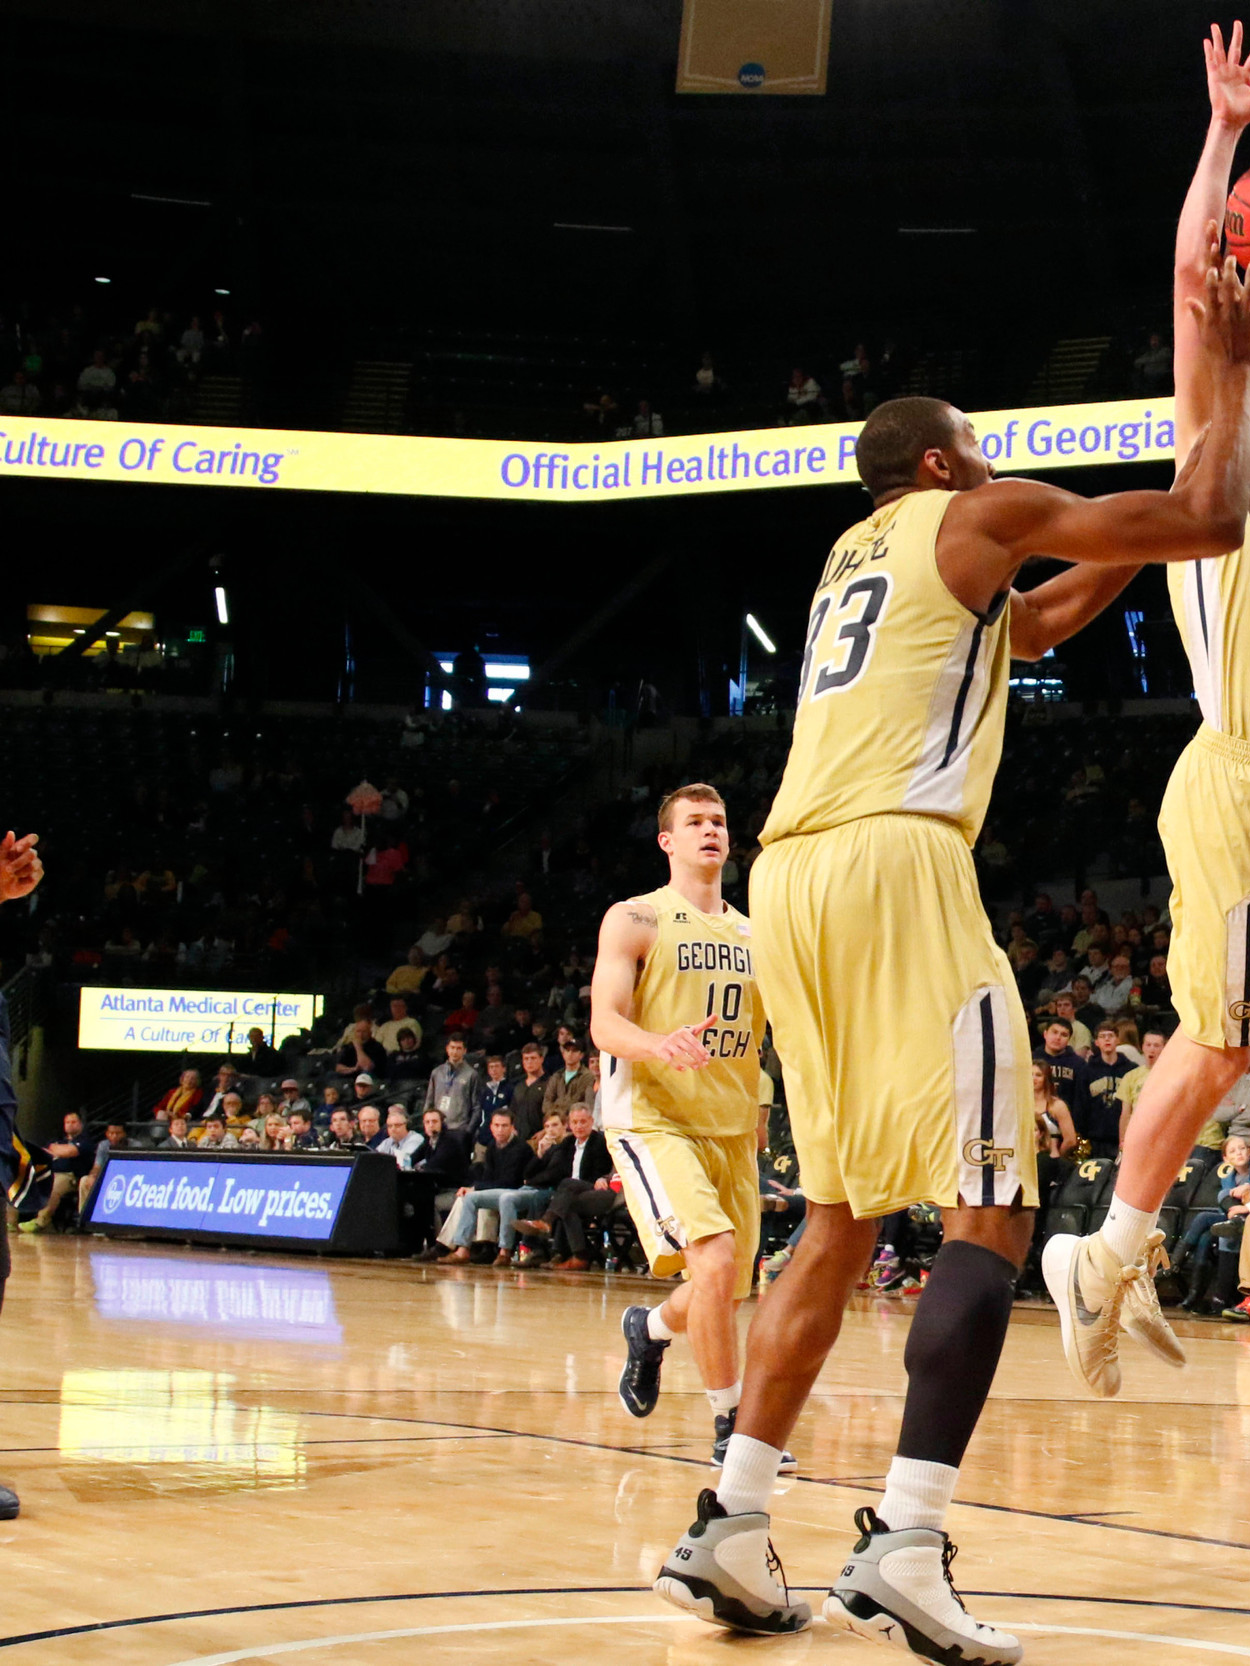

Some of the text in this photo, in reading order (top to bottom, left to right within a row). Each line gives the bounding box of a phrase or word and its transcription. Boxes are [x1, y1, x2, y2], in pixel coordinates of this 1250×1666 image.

[119, 438, 165, 471] Of
[172, 441, 284, 484] Caring
[501, 451, 632, 490] Official
[641, 443, 826, 485] Healthcare
[981, 420, 1019, 459] of
[1027, 410, 1175, 460] Georgia
[677, 942, 753, 977] GEORGI
[100, 994, 164, 1012] Atlanta
[169, 996, 238, 1015] Medical
[706, 982, 742, 1021] 10
[124, 1027, 135, 1041] A
[140, 1027, 195, 1043] Culture
[201, 1029, 222, 1043] Of
[701, 1027, 751, 1058] ECH
[774, 1155, 792, 1173] GT
[963, 1138, 1014, 1171] GT
[1079, 1161, 1101, 1181] GT
[125, 1174, 174, 1209] Great
[170, 1176, 215, 1212] food.
[217, 1178, 265, 1215] Low
[258, 1181, 333, 1227] prices.
[675, 1547, 692, 1561] 45
